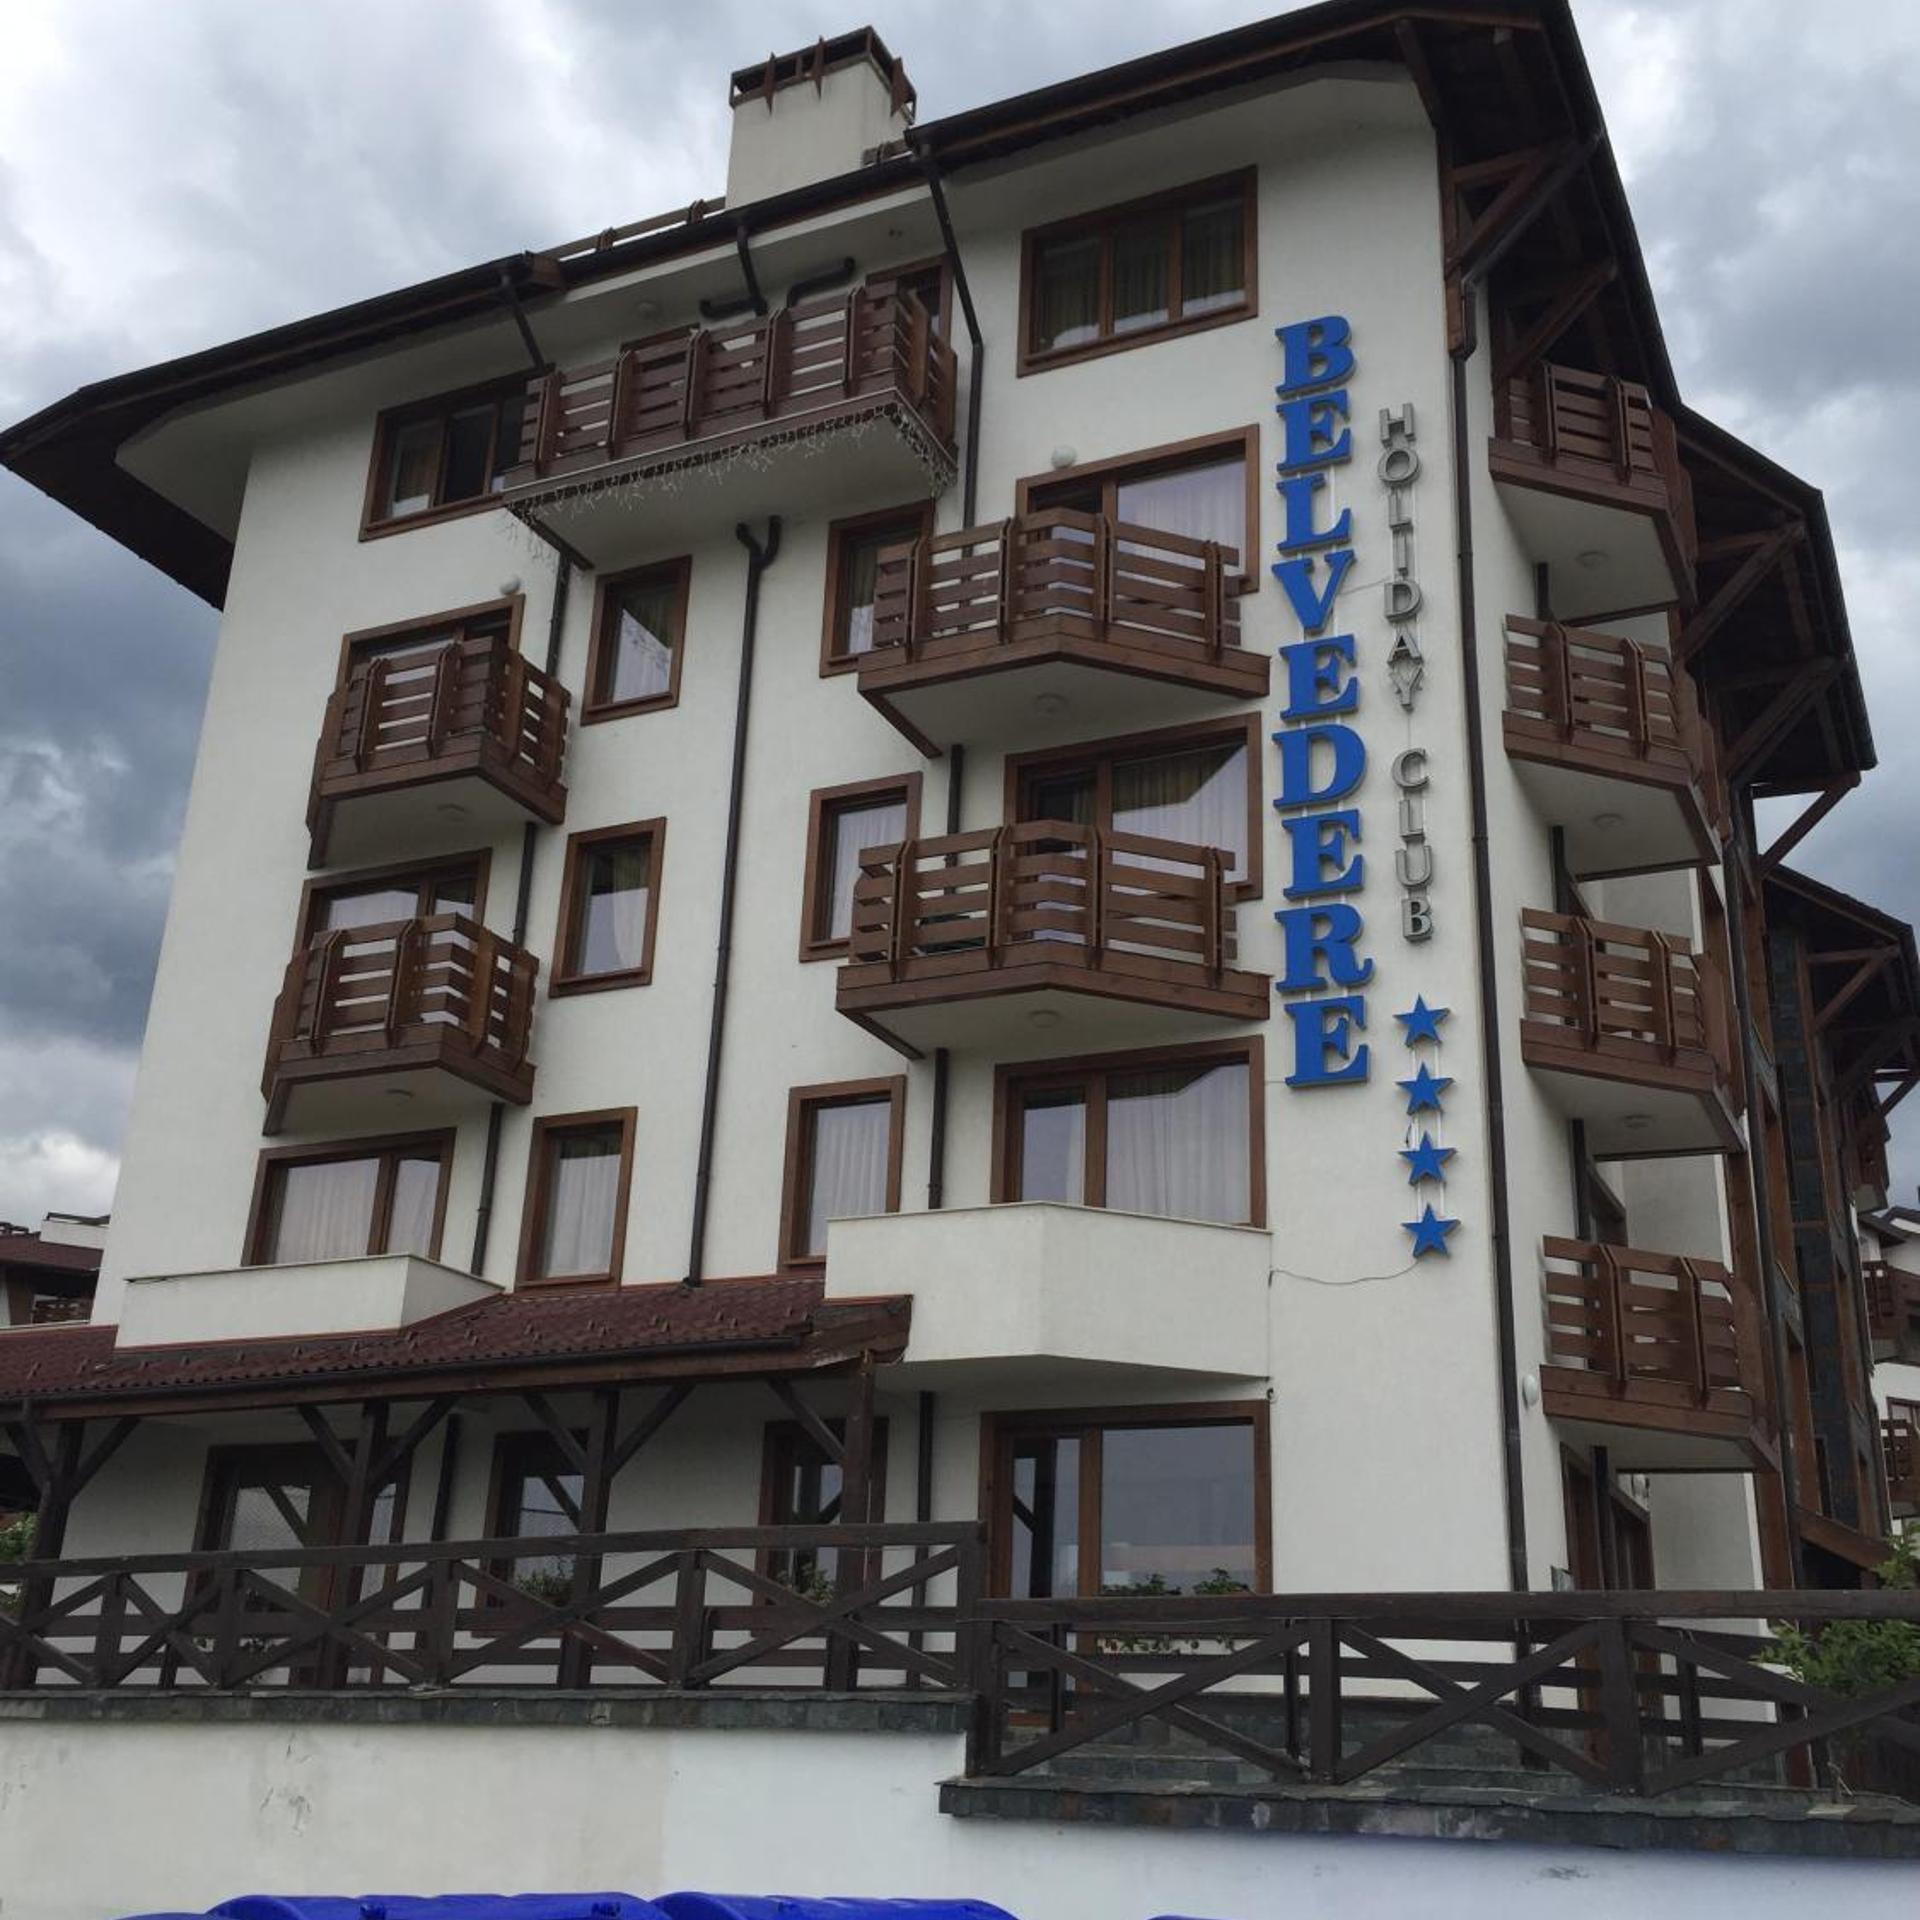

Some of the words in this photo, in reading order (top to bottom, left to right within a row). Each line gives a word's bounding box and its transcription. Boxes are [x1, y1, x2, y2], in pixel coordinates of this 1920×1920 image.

[1271, 315, 1375, 1089] BELVEDERE
[1377, 402, 1425, 712] HOLIDAY
[1391, 748, 1434, 942] CLUB
